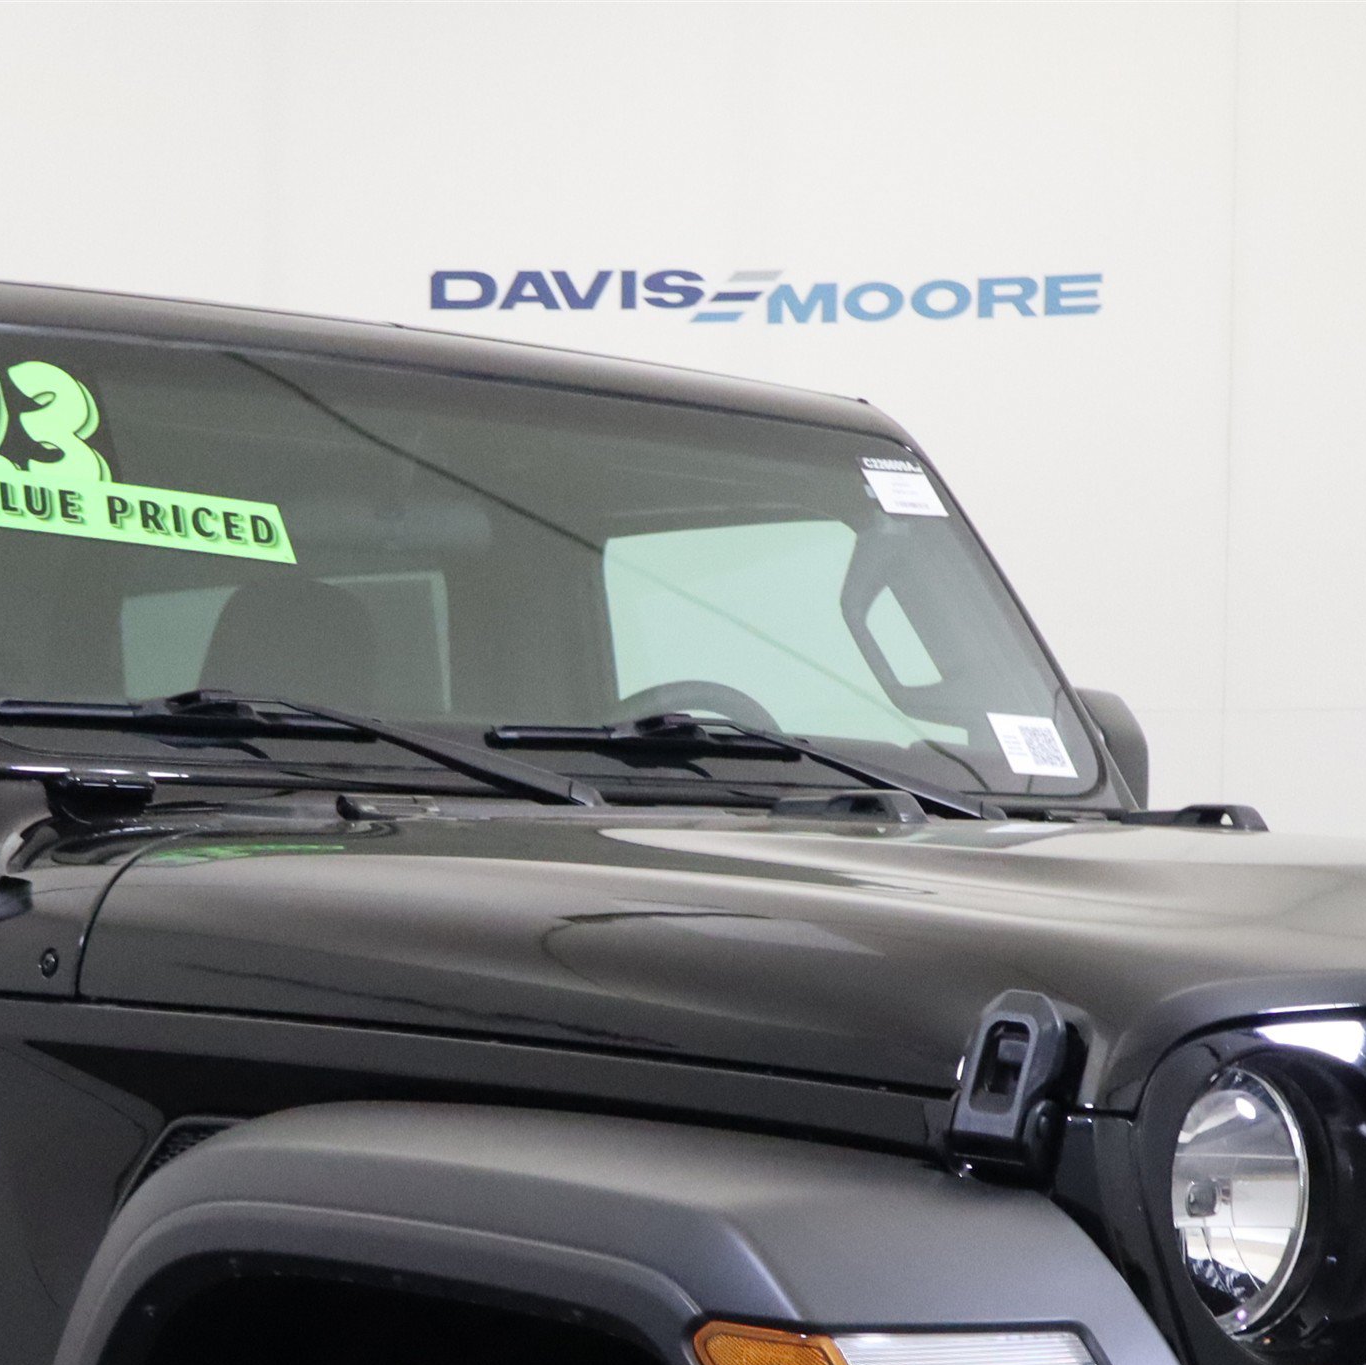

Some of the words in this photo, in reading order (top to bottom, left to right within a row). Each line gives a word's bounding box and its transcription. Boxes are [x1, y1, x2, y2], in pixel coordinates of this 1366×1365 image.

[430, 269, 708, 311] DAVIS
[765, 273, 1104, 325] MOORE
[106, 495, 278, 548] PRICED
